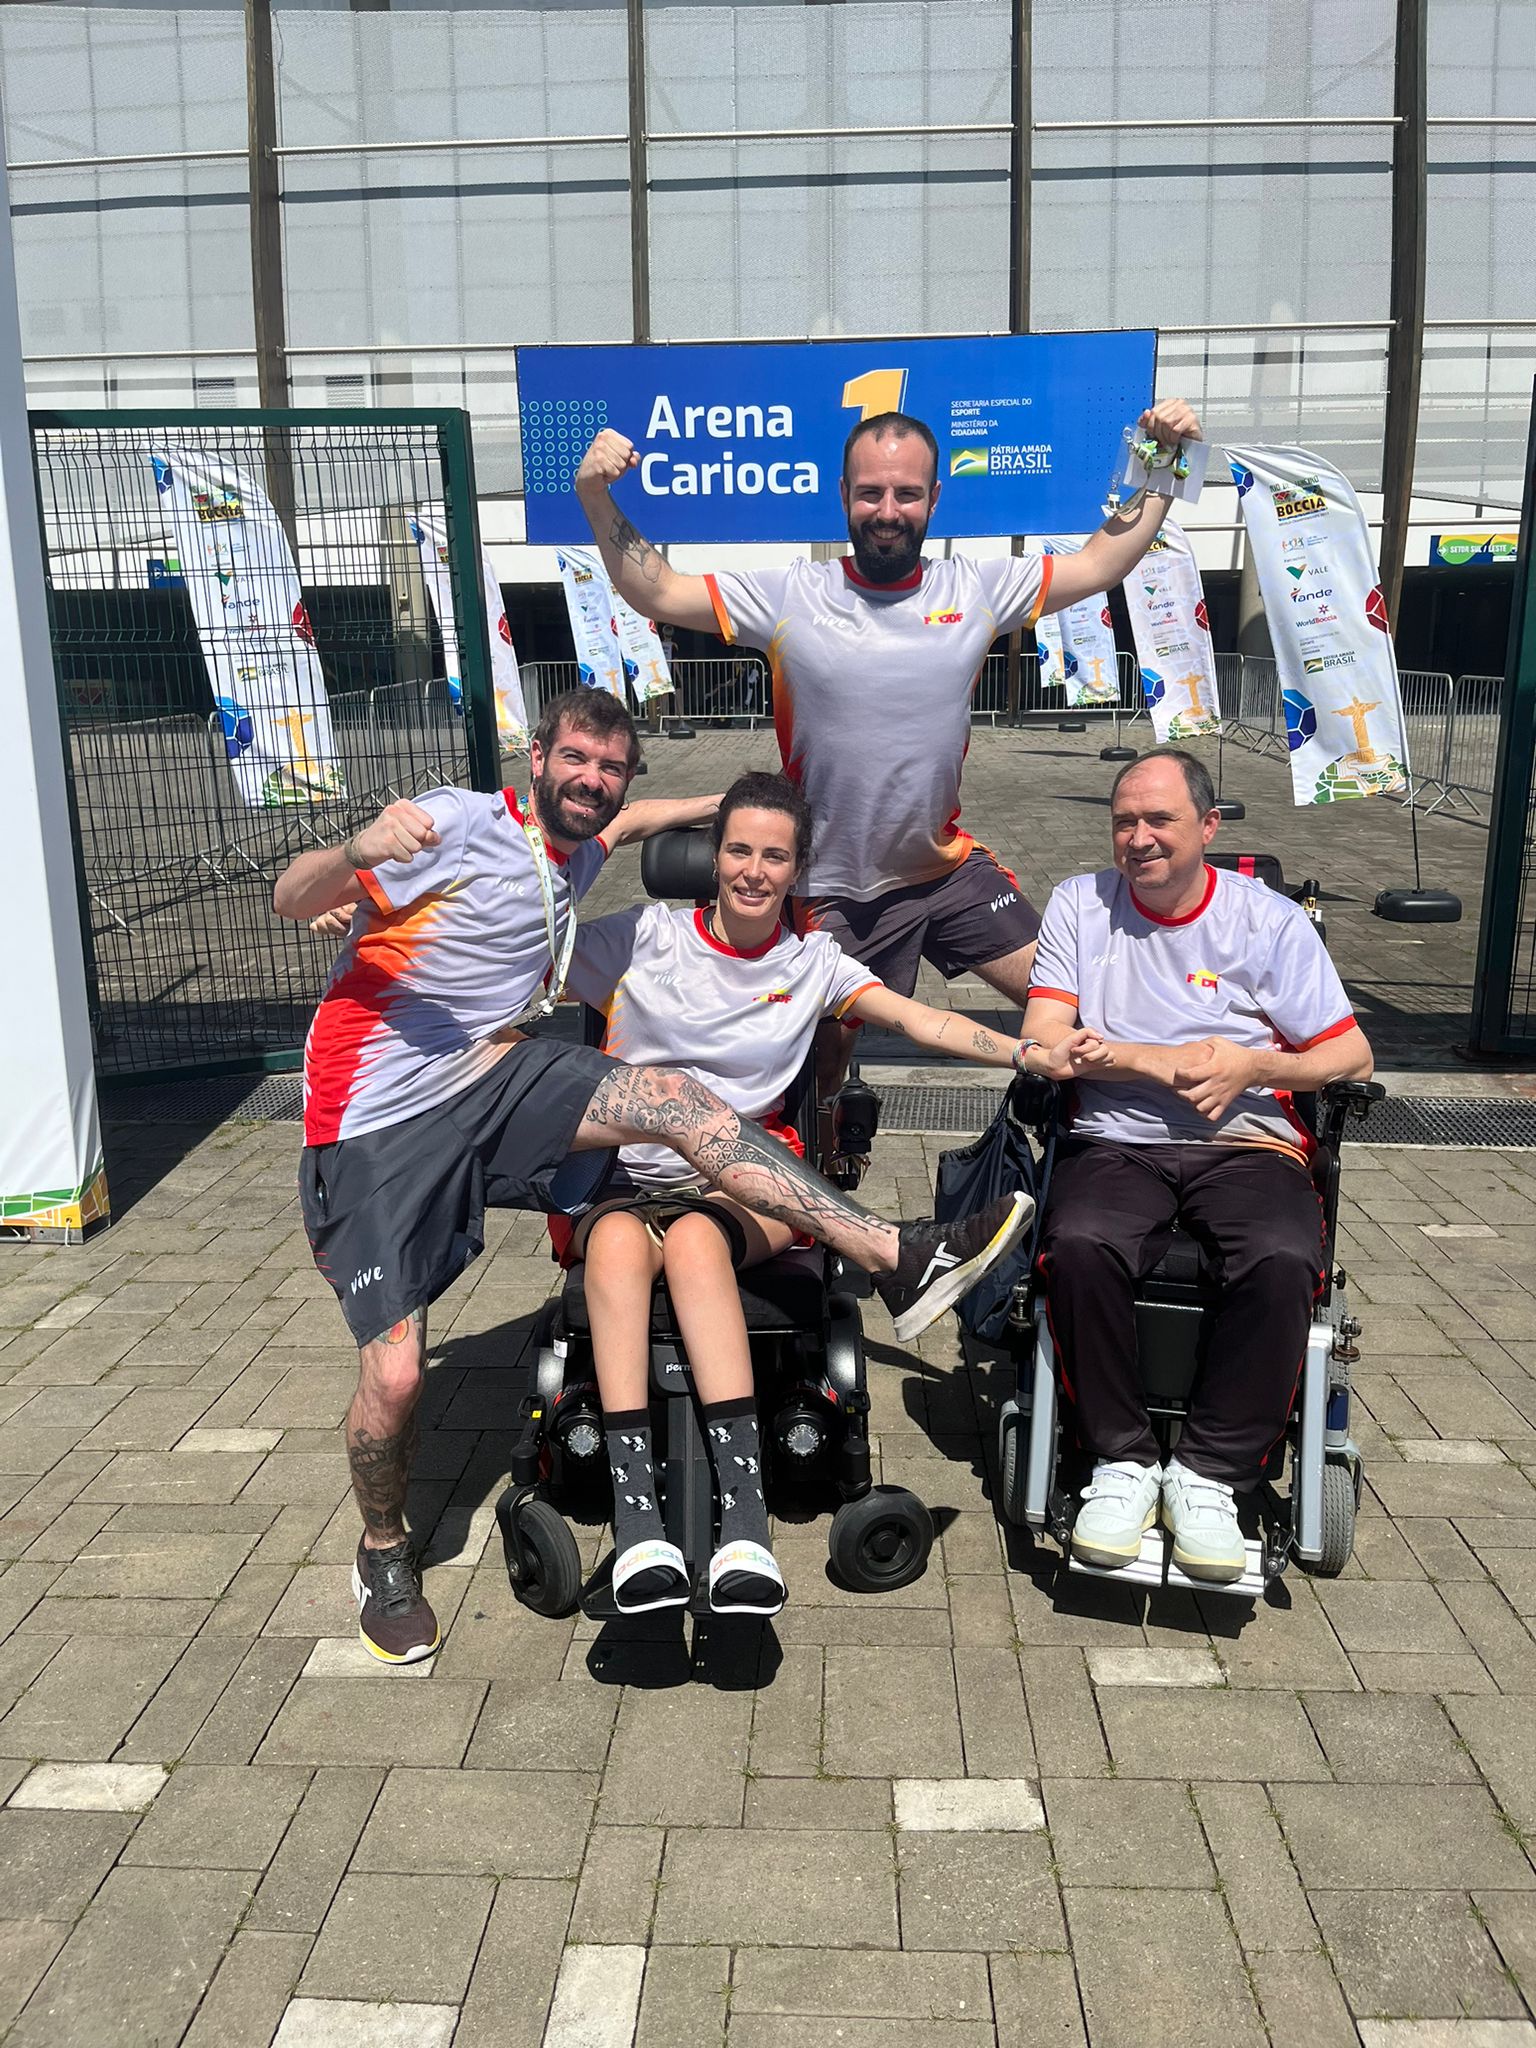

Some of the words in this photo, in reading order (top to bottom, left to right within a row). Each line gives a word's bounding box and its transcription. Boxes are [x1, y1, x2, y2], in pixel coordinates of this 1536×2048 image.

[842, 368, 909, 422] 1
[951, 400, 990, 409] SECRETARIA
[991, 399, 1021, 407] ESPECIAL
[1022, 398, 1032, 406] DO
[646, 395, 793, 438] Arena
[951, 408, 981, 417] ESPORTE
[951, 419, 988, 429] MINISTÉRIO
[989, 420, 999, 428] DA
[951, 428, 988, 437] CIDADANIA
[990, 444, 1019, 455] PÁTRIA
[1021, 444, 1053, 453] AMADA
[990, 453, 1052, 470] BRASIL
[641, 451, 819, 496] Carioca
[1276, 497, 1326, 518] BOCCIA
[1450, 545, 1470, 554] SETOR
[1470, 545, 1482, 553] SUL
[1488, 544, 1507, 553] LESTE
[1308, 566, 1329, 576] VALE
[1295, 615, 1338, 628] WorldBoccia
[1323, 655, 1357, 668] BRASIL
[991, 893, 1017, 912] vive
[653, 970, 682, 987] vive
[350, 1266, 384, 1296] vive
[615, 1547, 684, 1579] adidas
[712, 1548, 781, 1574] adidas
